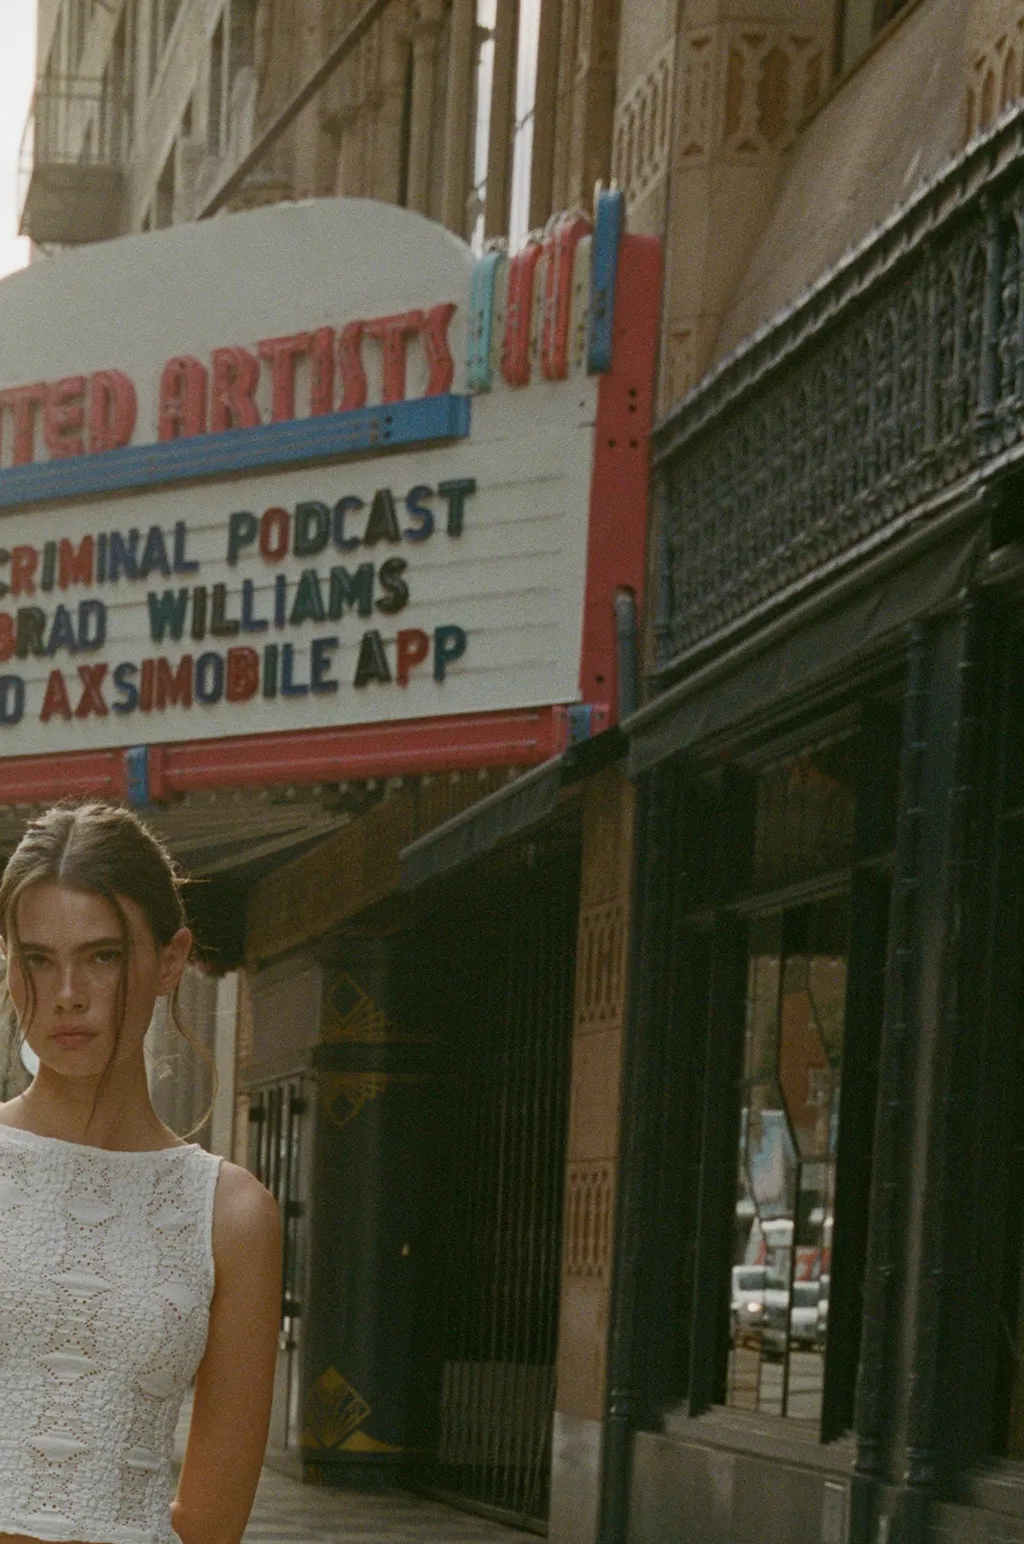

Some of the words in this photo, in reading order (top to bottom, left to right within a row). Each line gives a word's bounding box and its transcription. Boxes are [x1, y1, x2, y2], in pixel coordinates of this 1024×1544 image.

[157, 303, 457, 441] ARTISTS
[228, 477, 476, 566] PODCAST
[147, 557, 409, 642] WILLIAMS
[354, 625, 467, 688] APP
